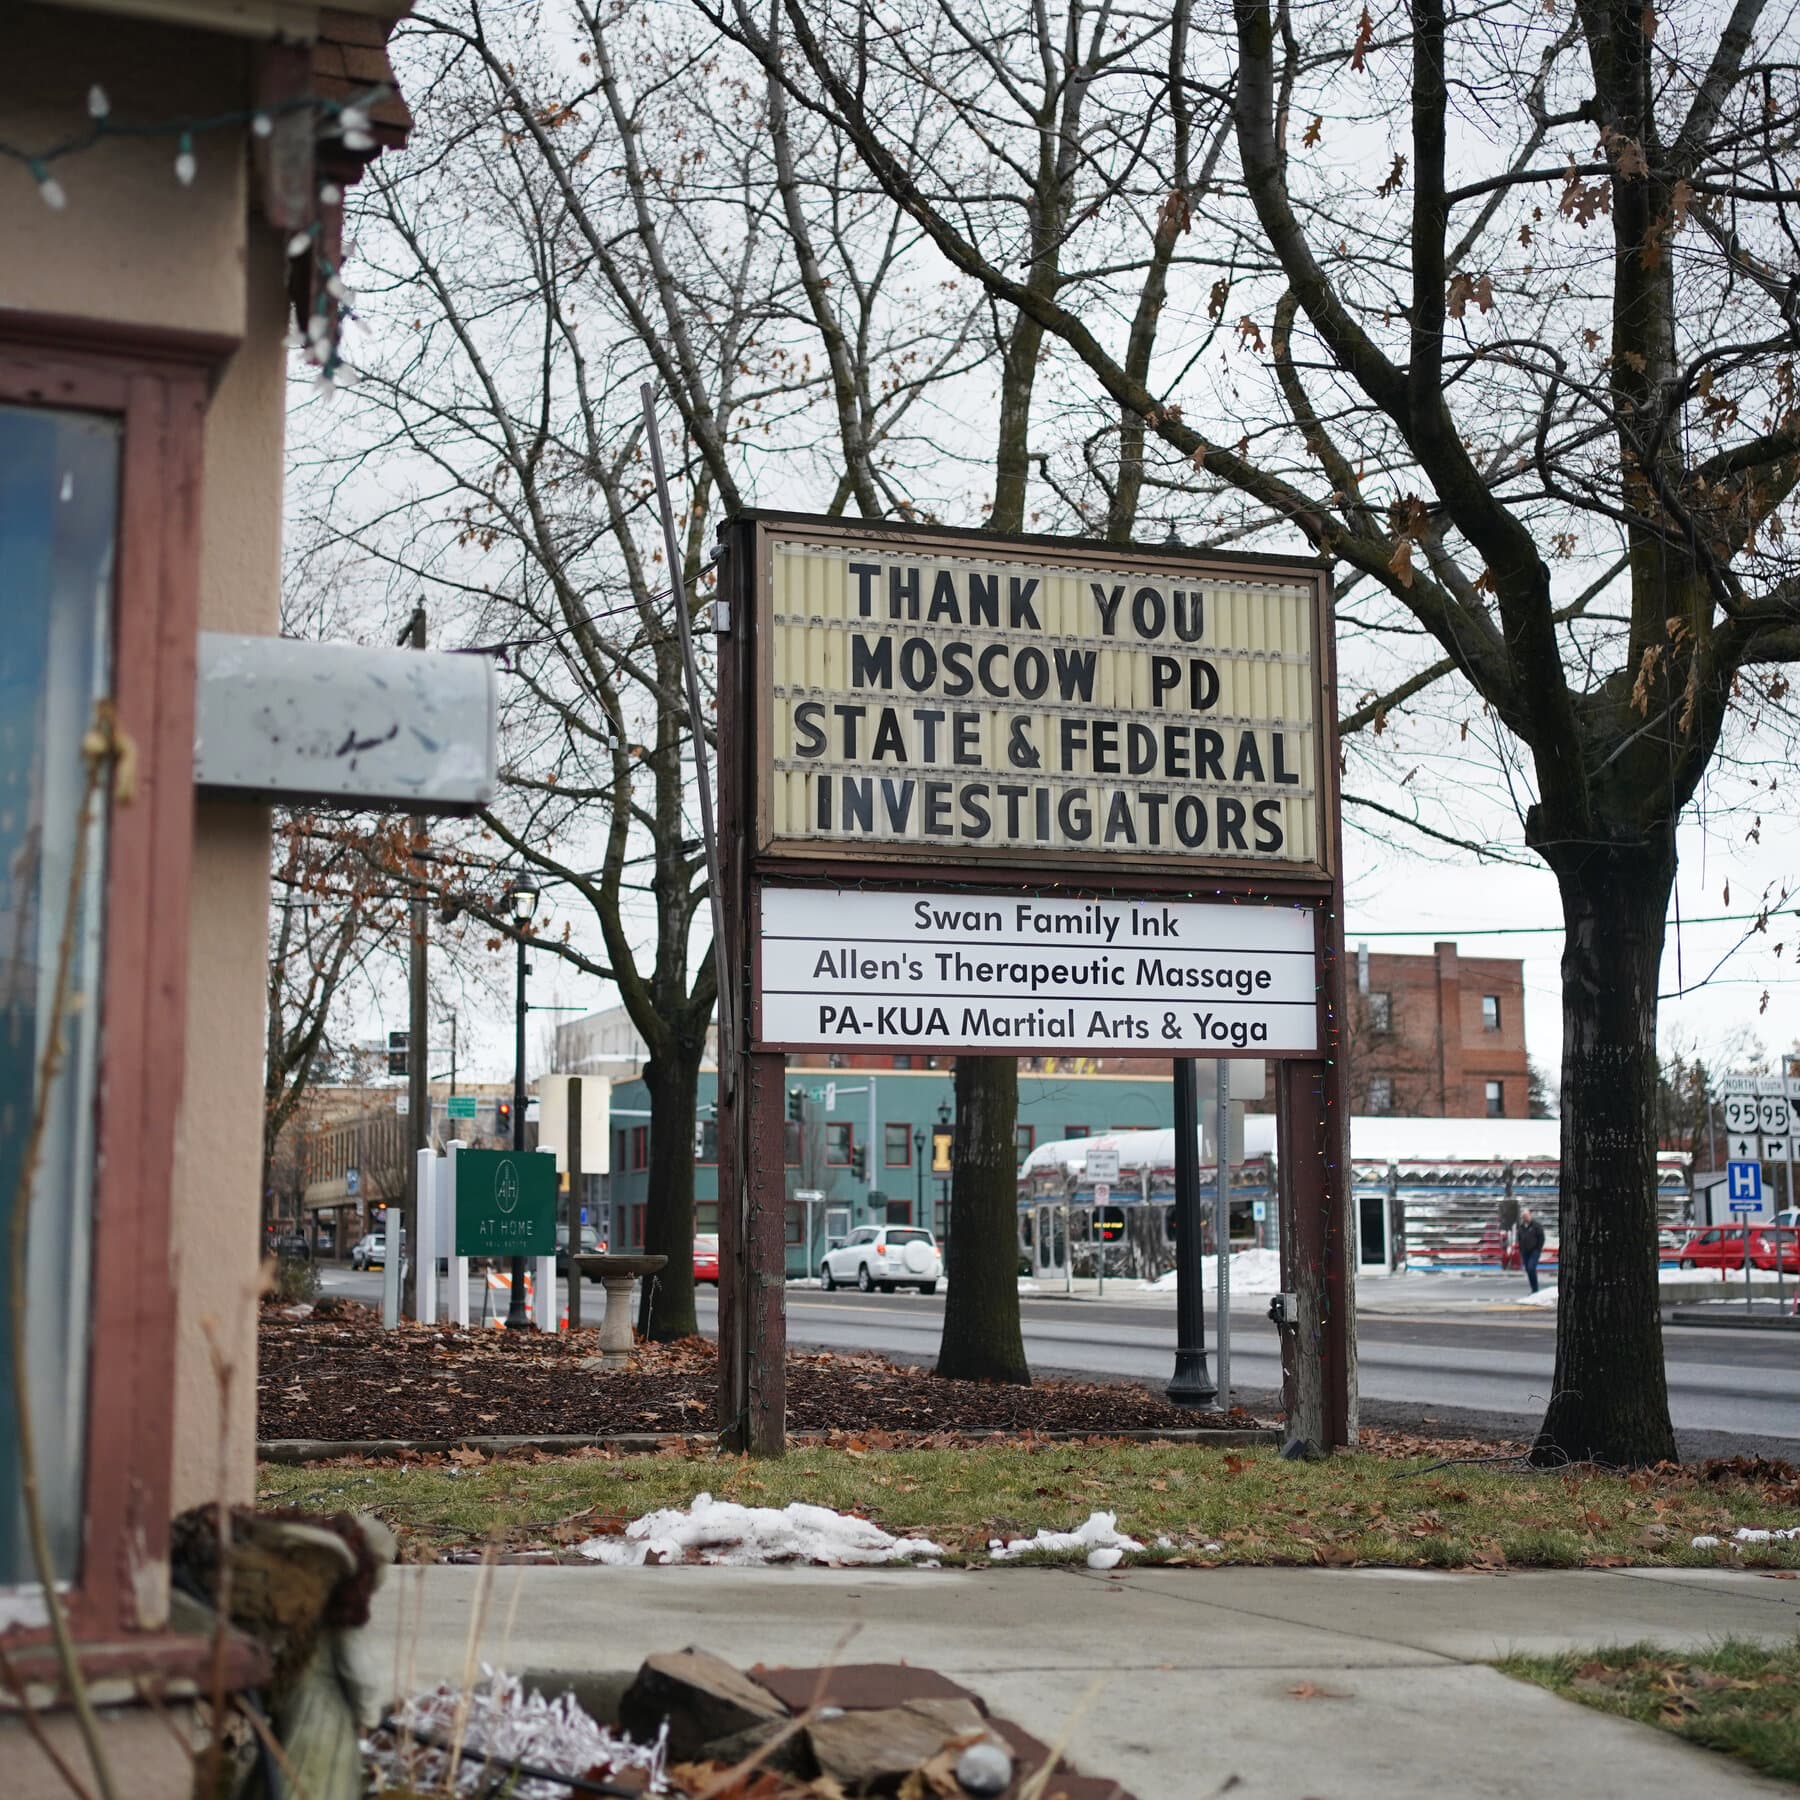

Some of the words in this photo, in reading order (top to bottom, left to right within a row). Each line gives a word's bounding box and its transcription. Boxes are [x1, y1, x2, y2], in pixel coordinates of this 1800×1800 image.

[849, 563, 1041, 630] THANK
[1090, 584, 1203, 642] YOU
[853, 635, 1096, 702] MOSCOW
[1152, 656, 1219, 711] PD
[795, 702, 981, 765] STATE
[1008, 716, 1040, 768] &
[1061, 719, 1298, 784] FEDERAL
[816, 774, 1284, 852] INVESTIGATORS
[915, 901, 1001, 931] Swan
[1016, 905, 1120, 942] Family
[1132, 908, 1179, 936] Ink
[813, 949, 922, 980] Allen's
[935, 952, 1124, 991] Therapeutic
[1136, 959, 1271, 995] Massage
[820, 1006, 949, 1035] PA-KUA
[961, 1008, 1074, 1037] Martial
[1088, 1011, 1149, 1039] Arts
[1162, 1012, 1182, 1039] &
[1194, 1013, 1269, 1048] Yoga
[1726, 1079, 1755, 1089] NORTH
[1729, 1103, 1755, 1124] 95
[1762, 1105, 1786, 1126] 95
[1734, 1166, 1755, 1197] H
[480, 1220, 496, 1235] AT
[501, 1220, 533, 1236] HOME
